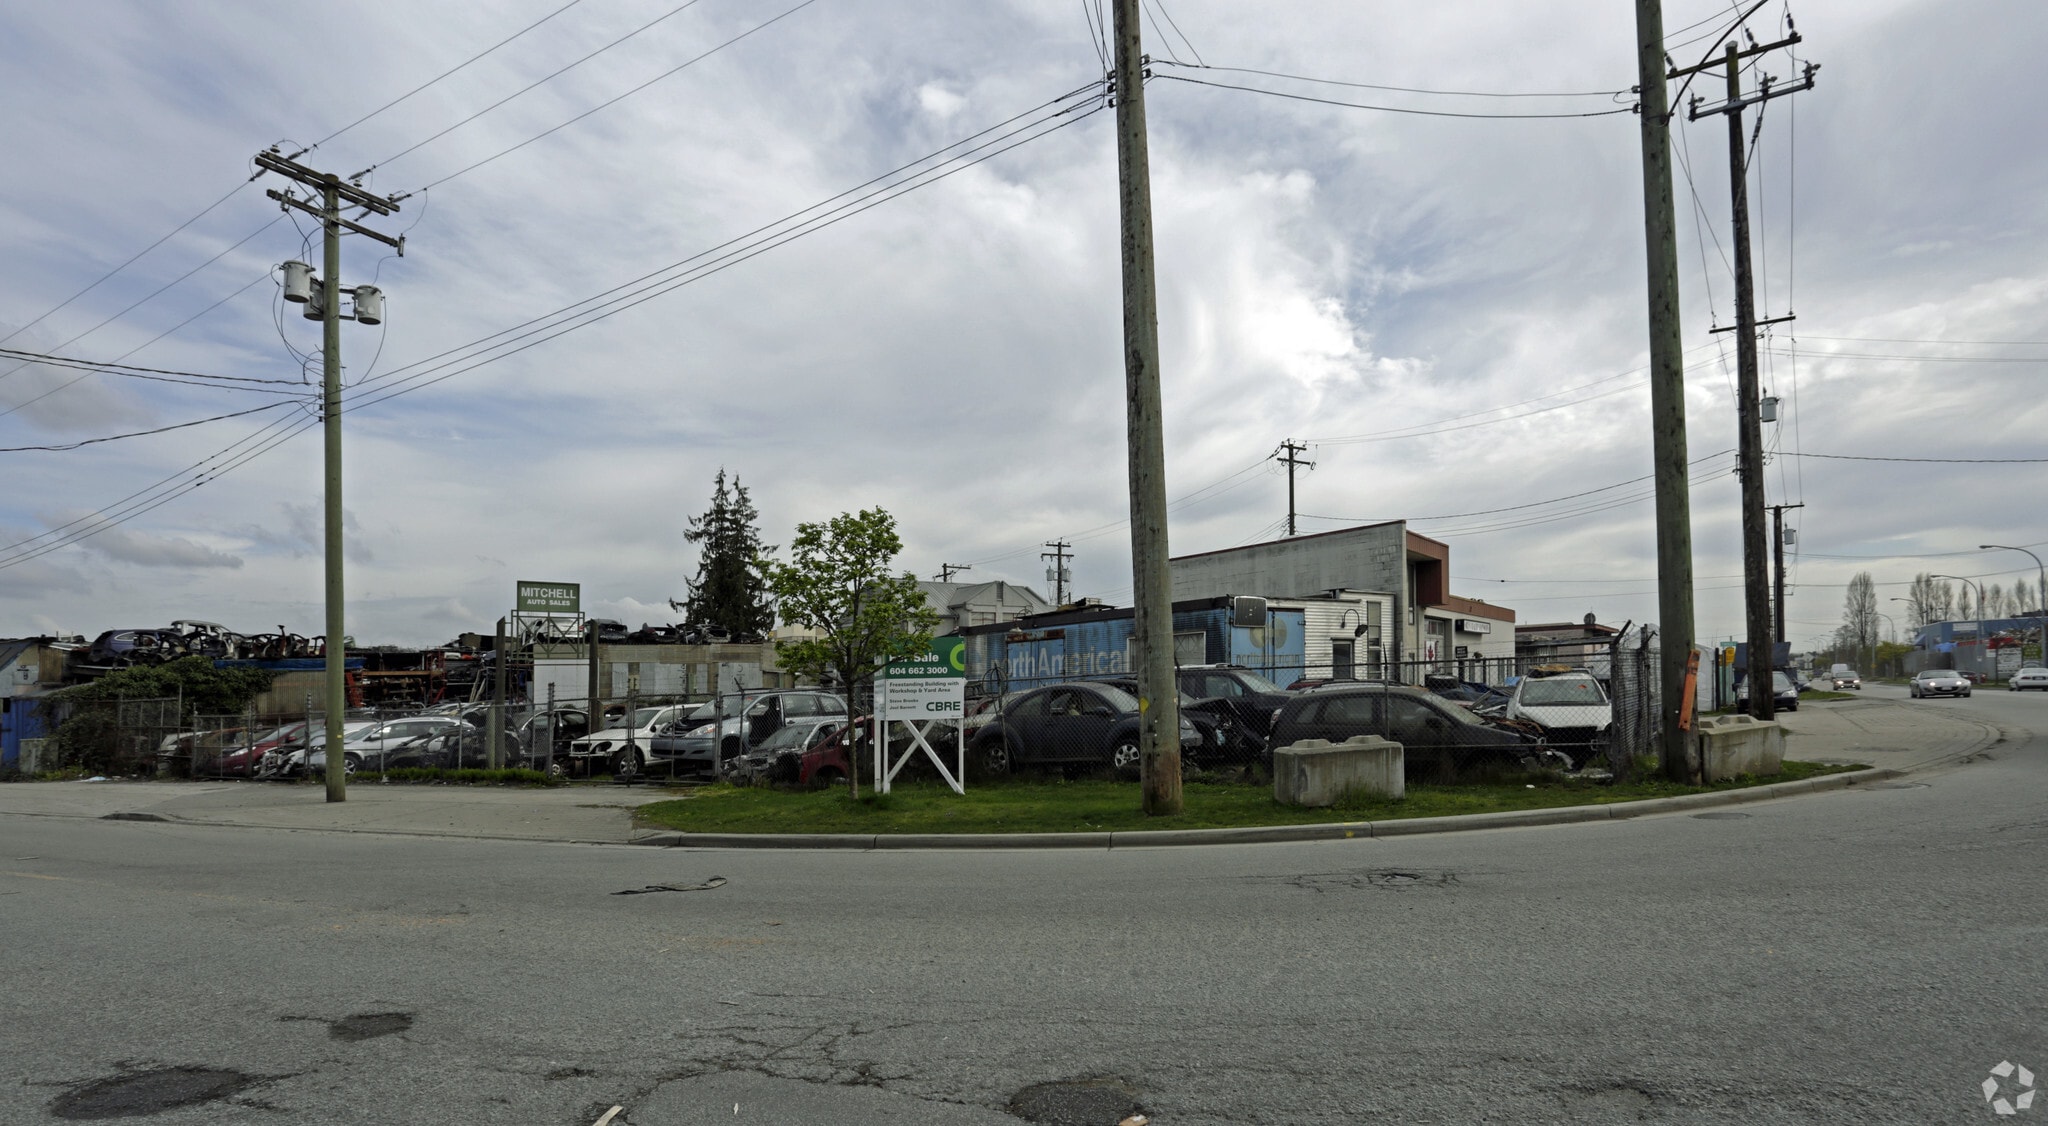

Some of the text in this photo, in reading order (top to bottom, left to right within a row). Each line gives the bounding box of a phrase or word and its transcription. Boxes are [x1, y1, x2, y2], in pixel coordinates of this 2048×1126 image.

[521, 587, 576, 599] MITCHELL
[914, 652, 939, 662] Sale
[926, 701, 961, 712] CBRE
